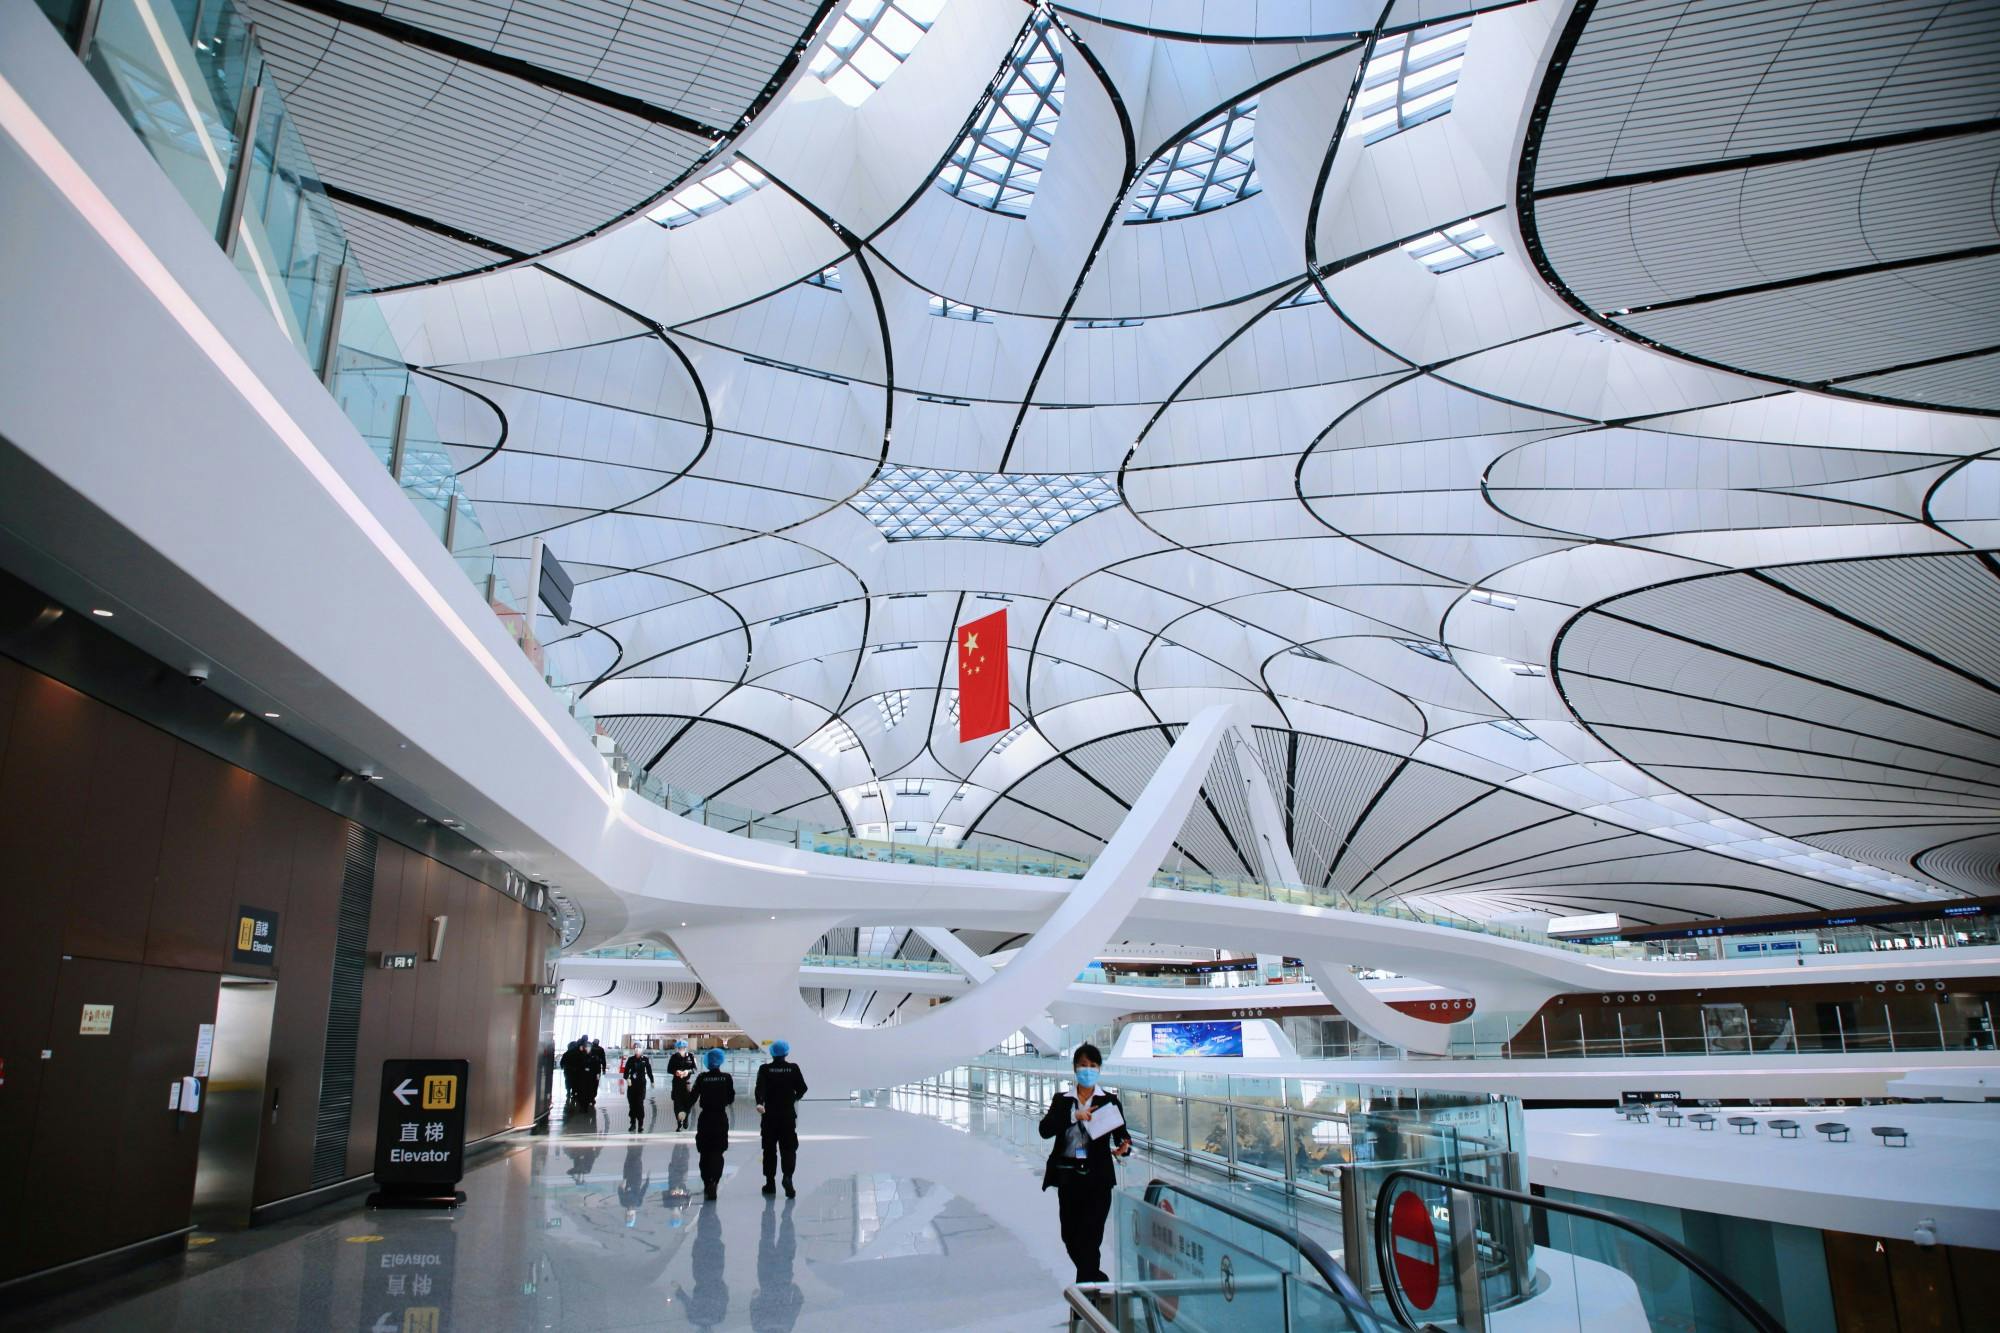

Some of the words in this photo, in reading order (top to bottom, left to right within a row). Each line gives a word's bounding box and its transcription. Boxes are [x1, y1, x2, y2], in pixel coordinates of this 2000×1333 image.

[255, 921, 269, 936] 直梯
[253, 941, 273, 953] Elevator
[400, 1122, 444, 1142] 直梯
[390, 1149, 450, 1162] Elevator
[1875, 1240, 1885, 1252] A
